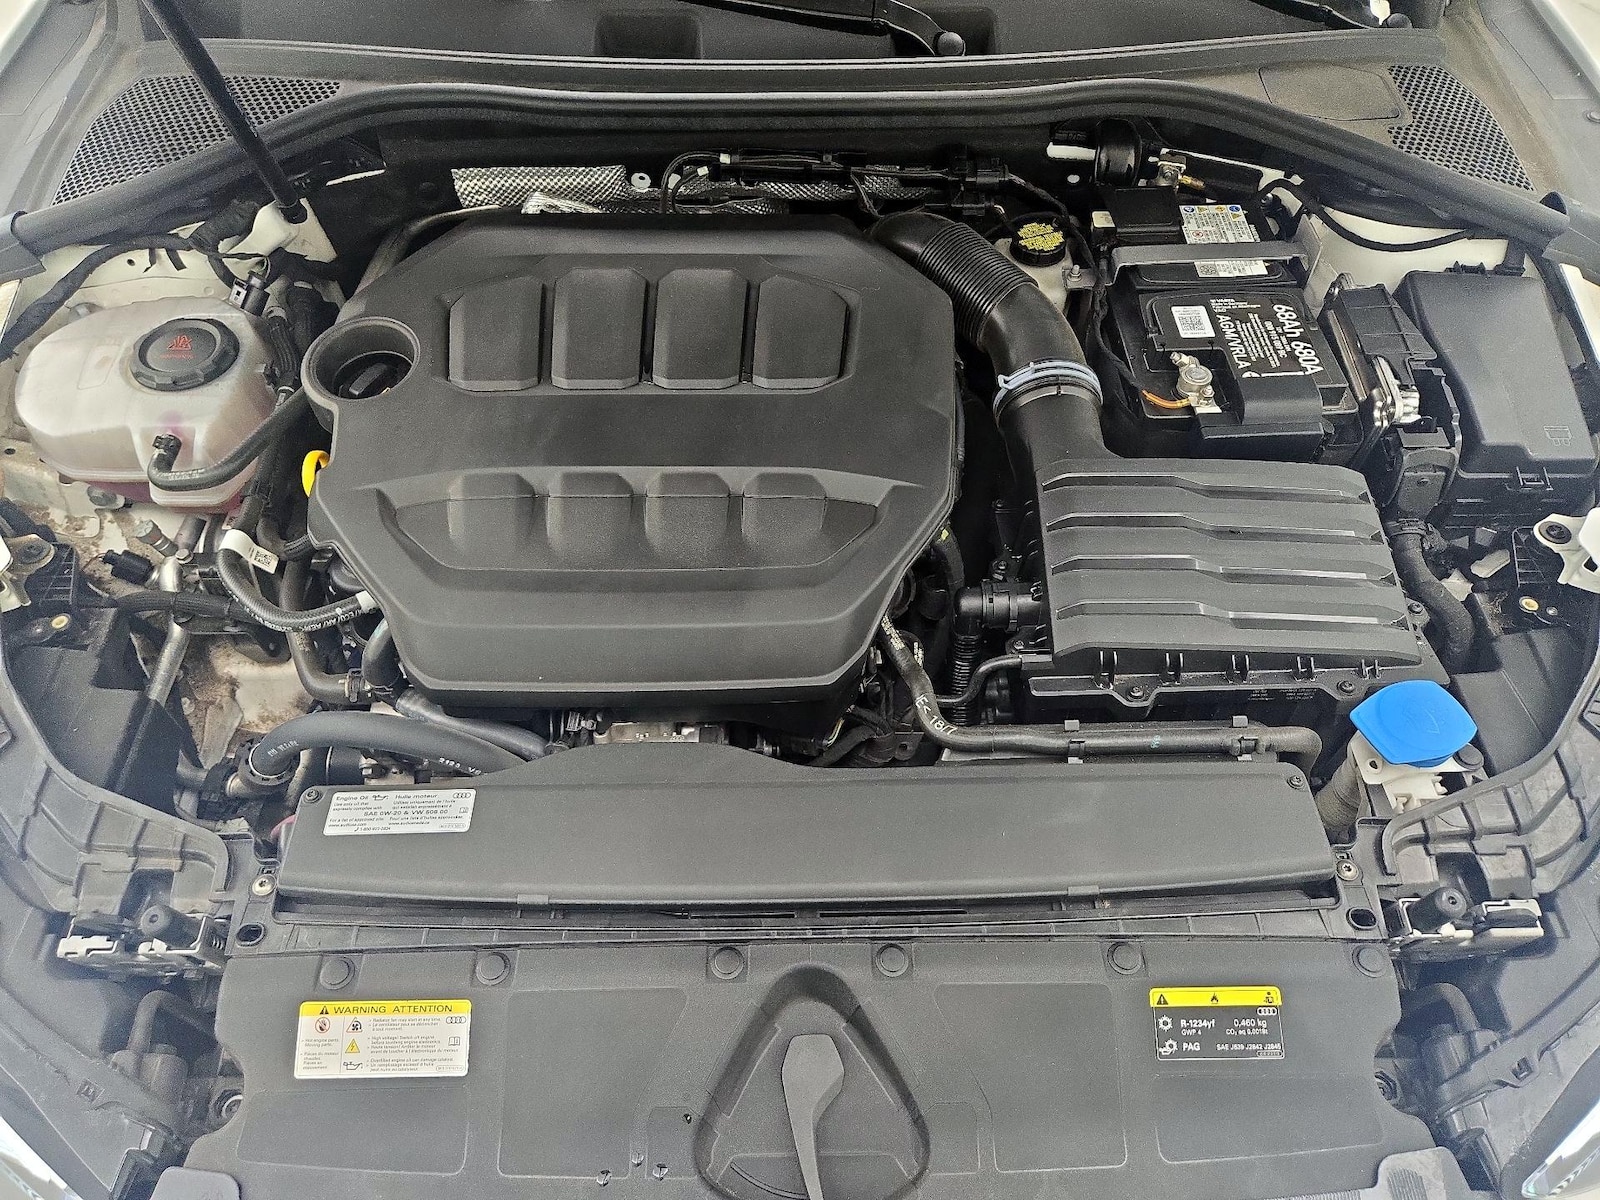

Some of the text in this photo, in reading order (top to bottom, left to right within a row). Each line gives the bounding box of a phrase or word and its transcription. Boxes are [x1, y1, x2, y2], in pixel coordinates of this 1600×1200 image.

[1216, 314, 1252, 369] AGM/VRLA
[1272, 304, 1324, 376] 68Ah 680A
[334, 1004, 452, 1014] WARNING ATTENTION
[1180, 1019, 1216, 1029] R-1234yf
[1257, 1018, 1268, 1028] kg
[1182, 1042, 1200, 1050] PAG
